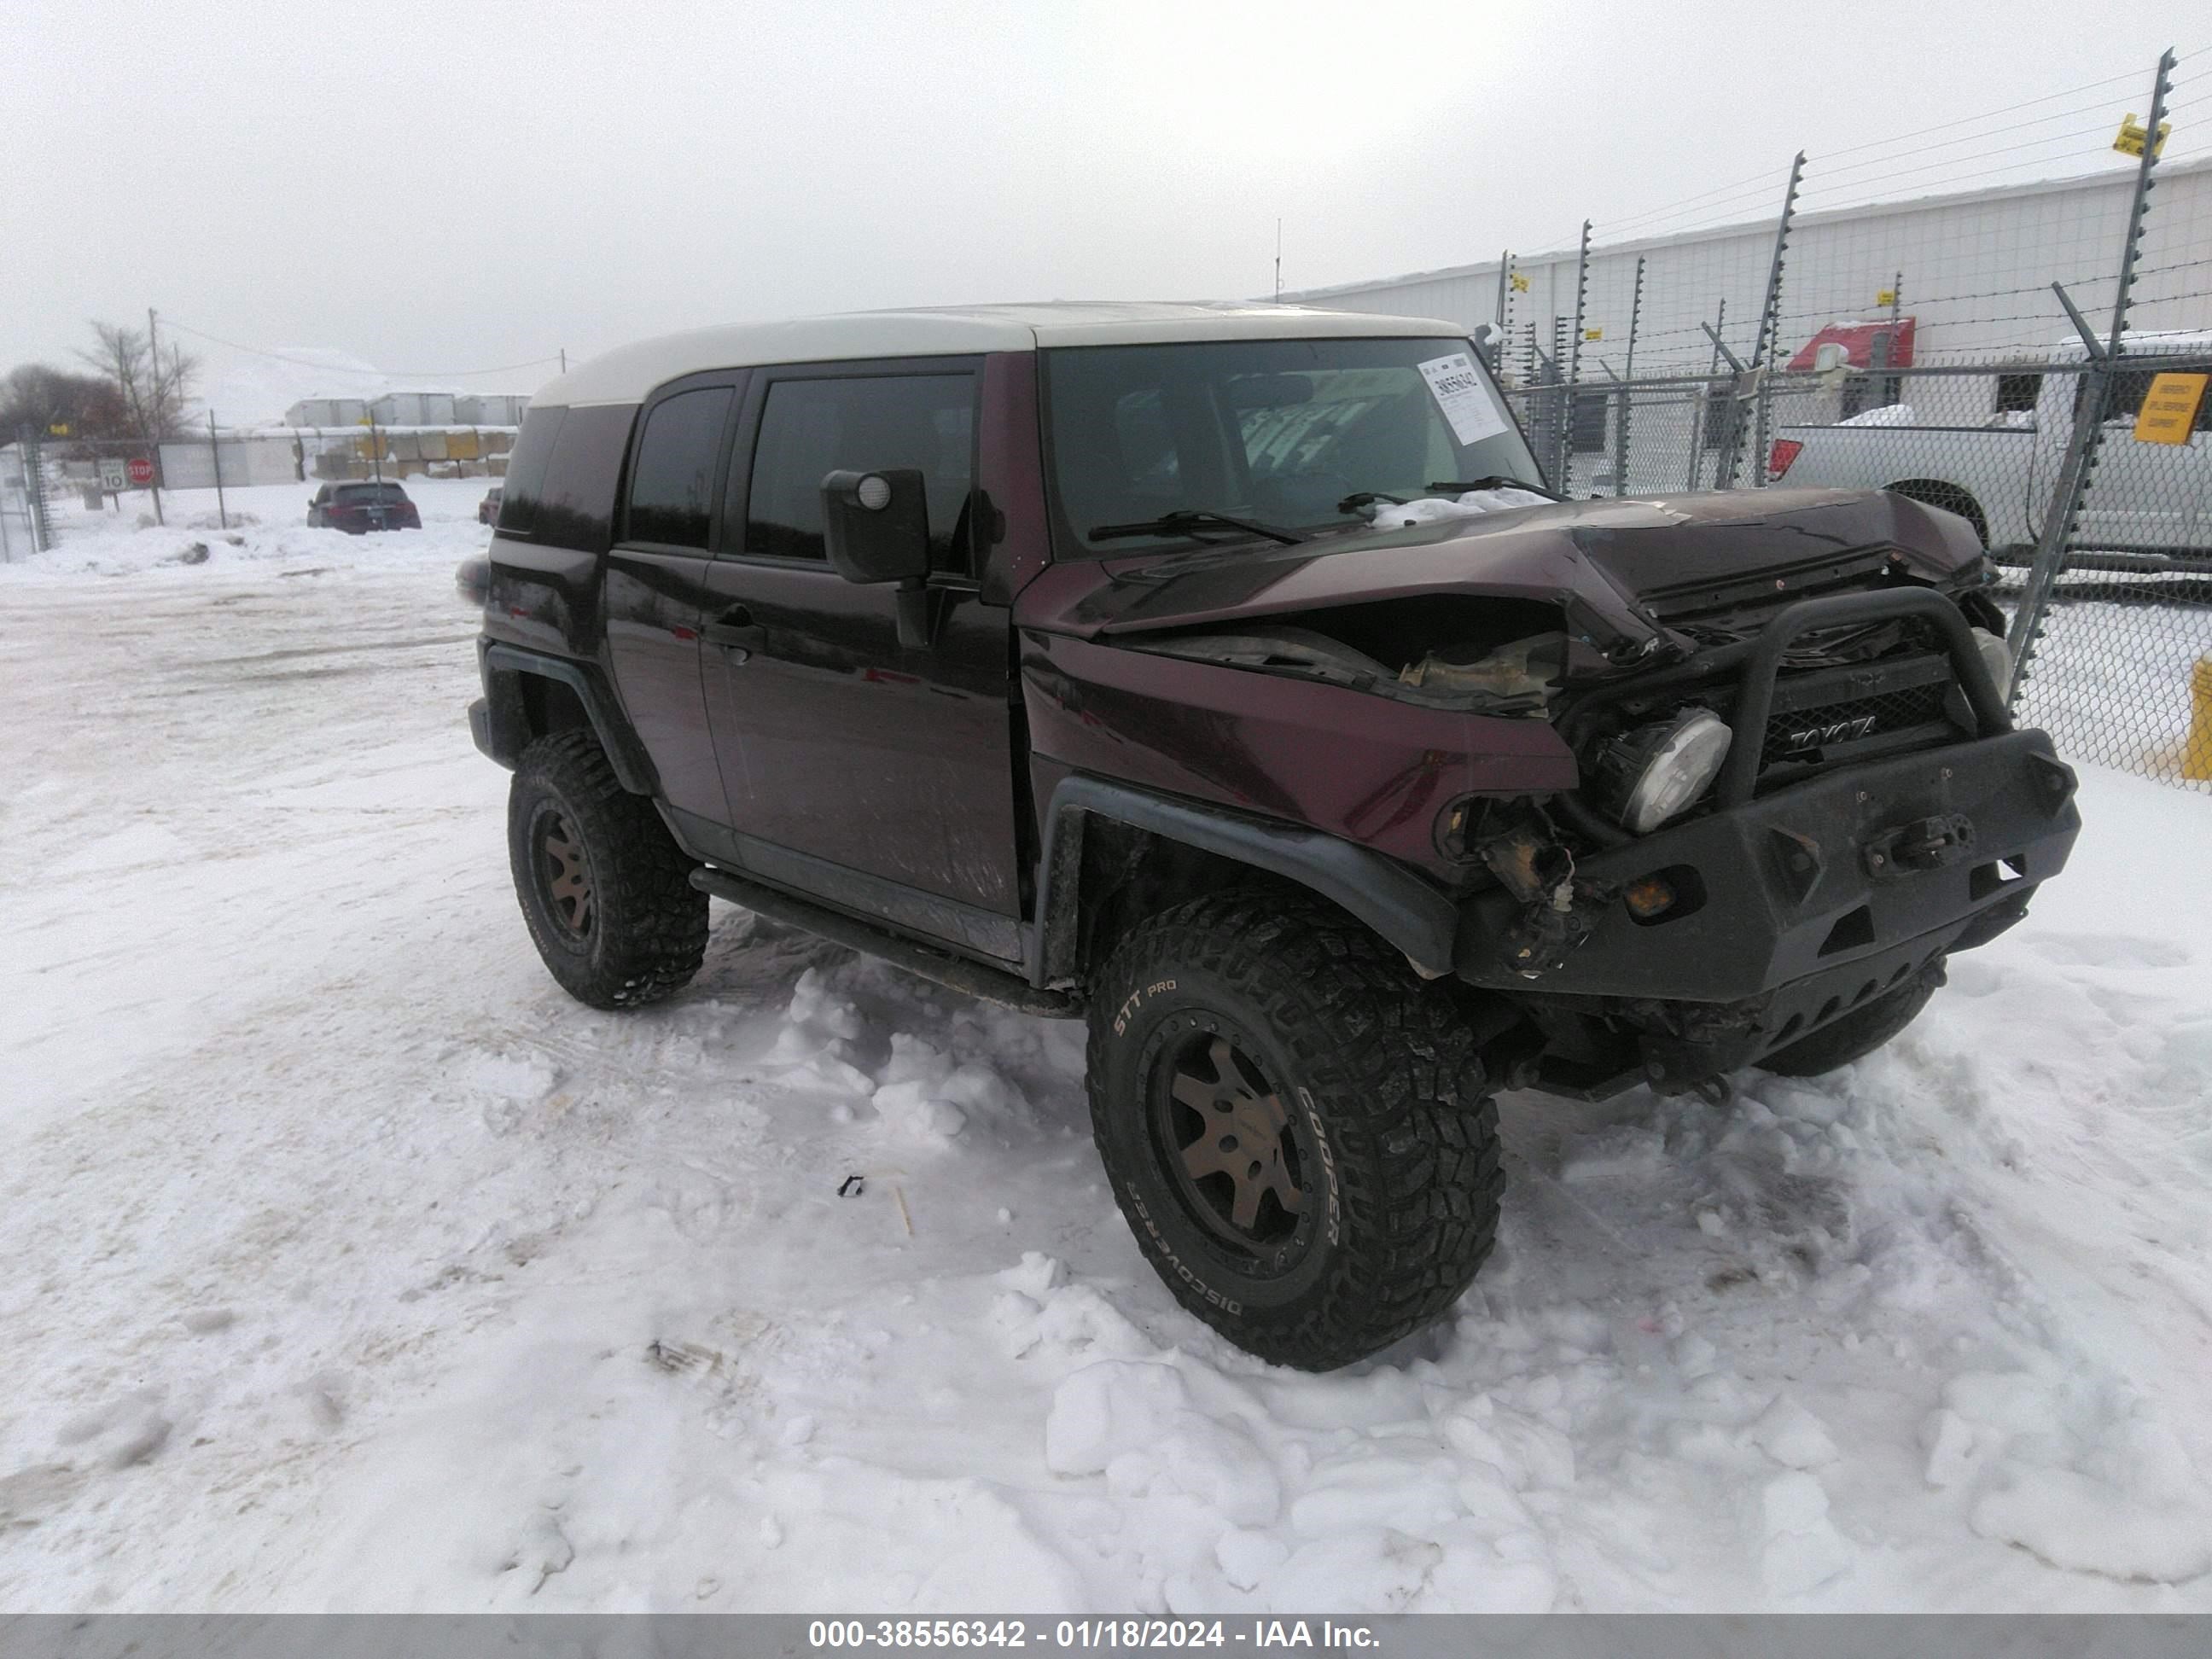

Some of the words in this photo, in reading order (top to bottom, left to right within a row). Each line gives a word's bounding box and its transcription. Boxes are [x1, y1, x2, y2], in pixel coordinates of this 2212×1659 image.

[105, 475, 122, 488] 10
[128, 464, 154, 477] STOP
[1790, 716, 1876, 746] TOYOTA
[1114, 989, 1141, 1038] STT
[1147, 980, 1177, 998] PRO
[1298, 1086, 1341, 1247] COOPER
